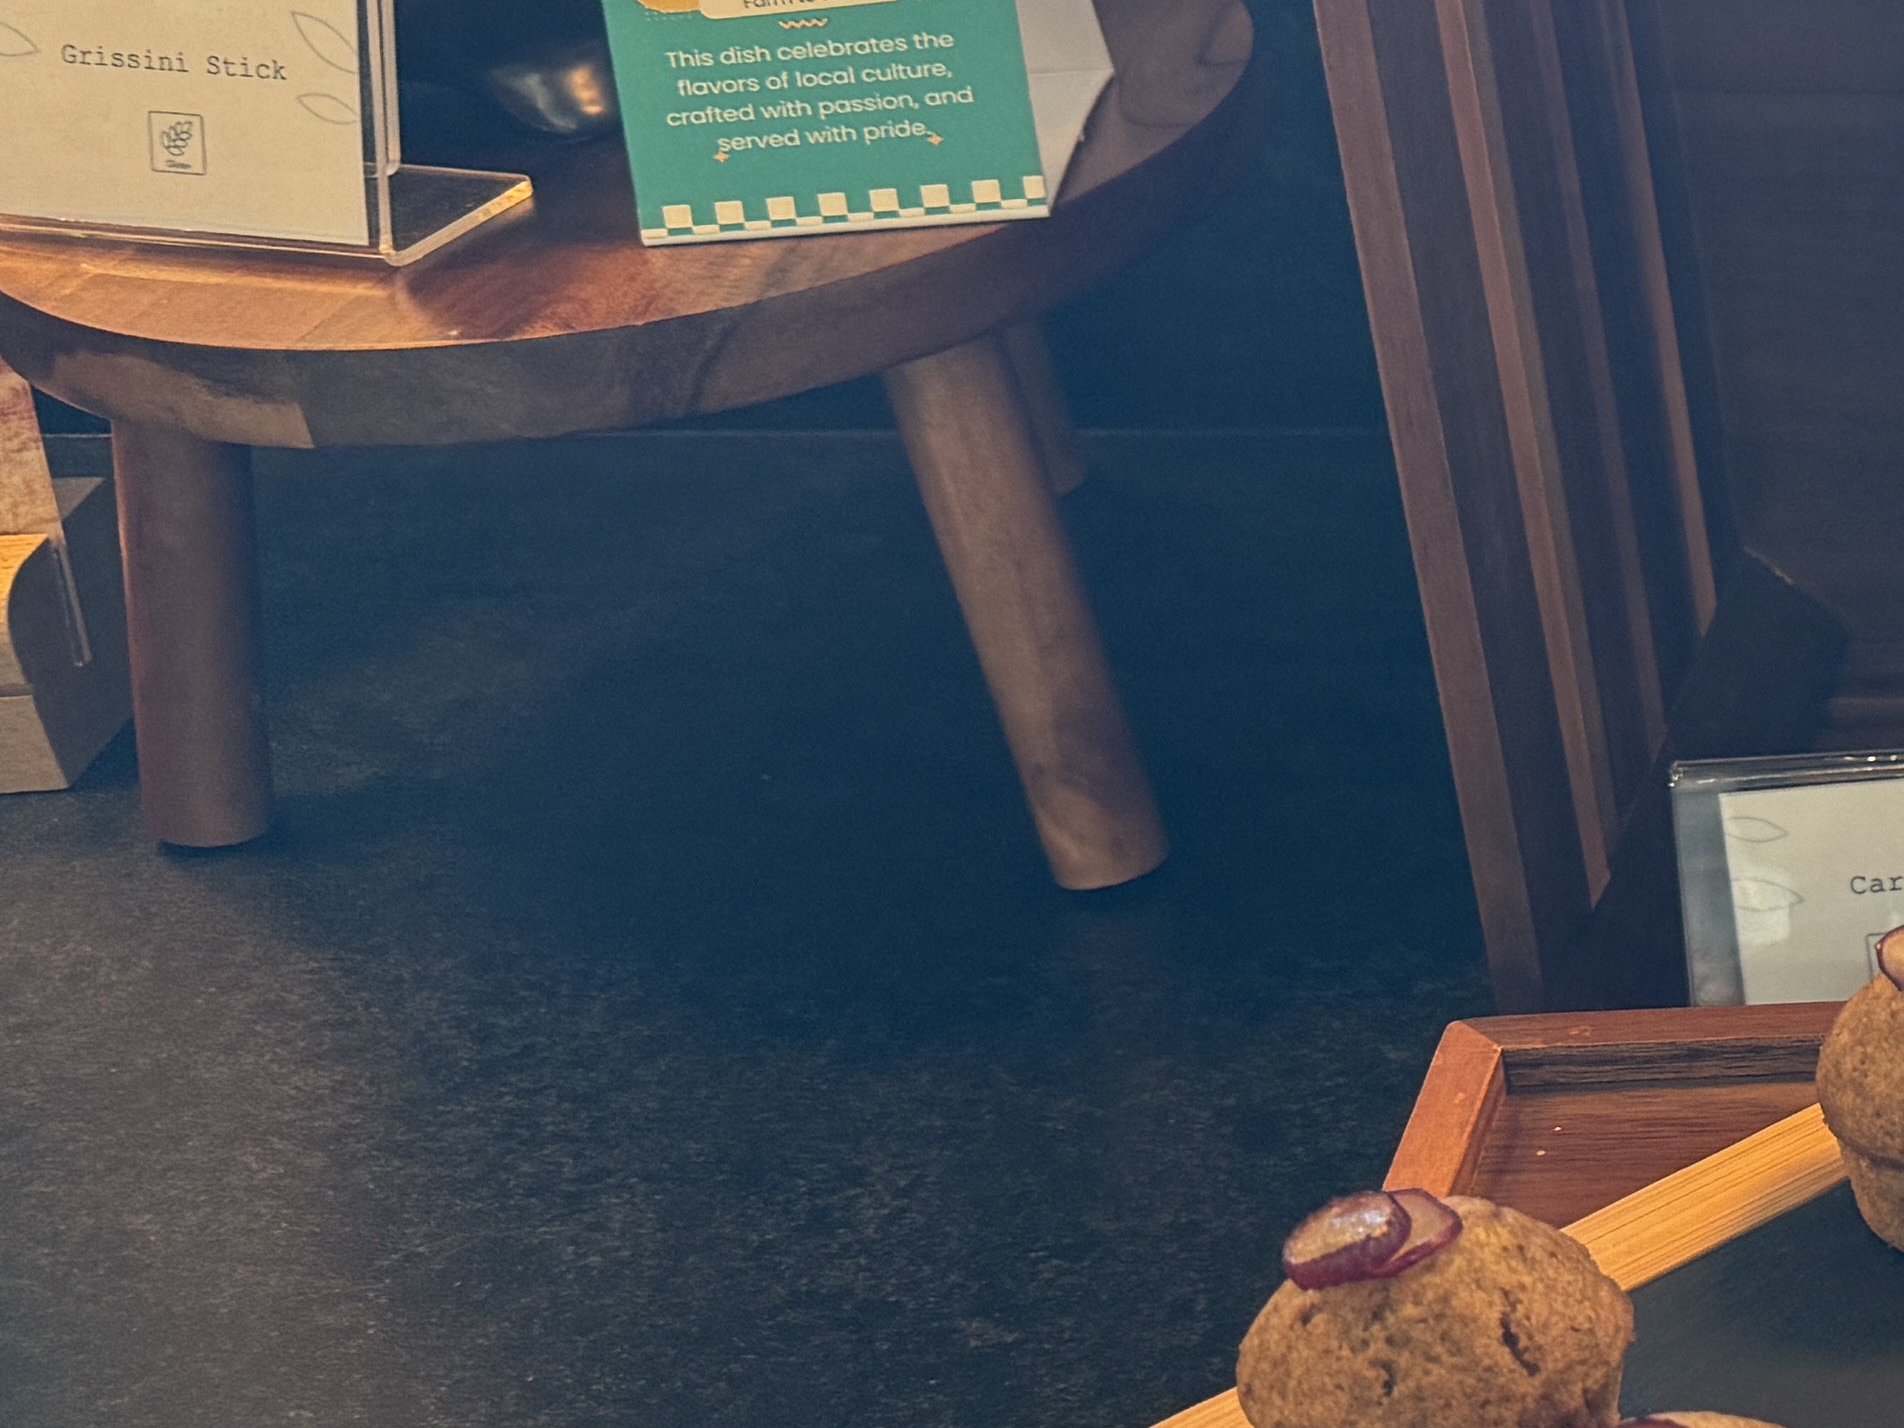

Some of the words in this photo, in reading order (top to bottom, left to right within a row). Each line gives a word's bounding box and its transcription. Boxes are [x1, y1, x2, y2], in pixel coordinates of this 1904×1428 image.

[60, 43, 190, 74] Grissini
[205, 55, 288, 81] Stick
[665, 49, 715, 68] This
[719, 44, 771, 66] dish
[776, 34, 908, 61] celebrates
[913, 31, 955, 49] the
[676, 75, 761, 97] flavors
[765, 70, 789, 91] of
[795, 65, 856, 89] local
[861, 60, 953, 83] culture,
[666, 103, 756, 127] crafted
[759, 98, 812, 119] with
[818, 91, 920, 120] passion,
[923, 85, 975, 106] and
[717, 129, 801, 152] served
[805, 124, 858, 145] with
